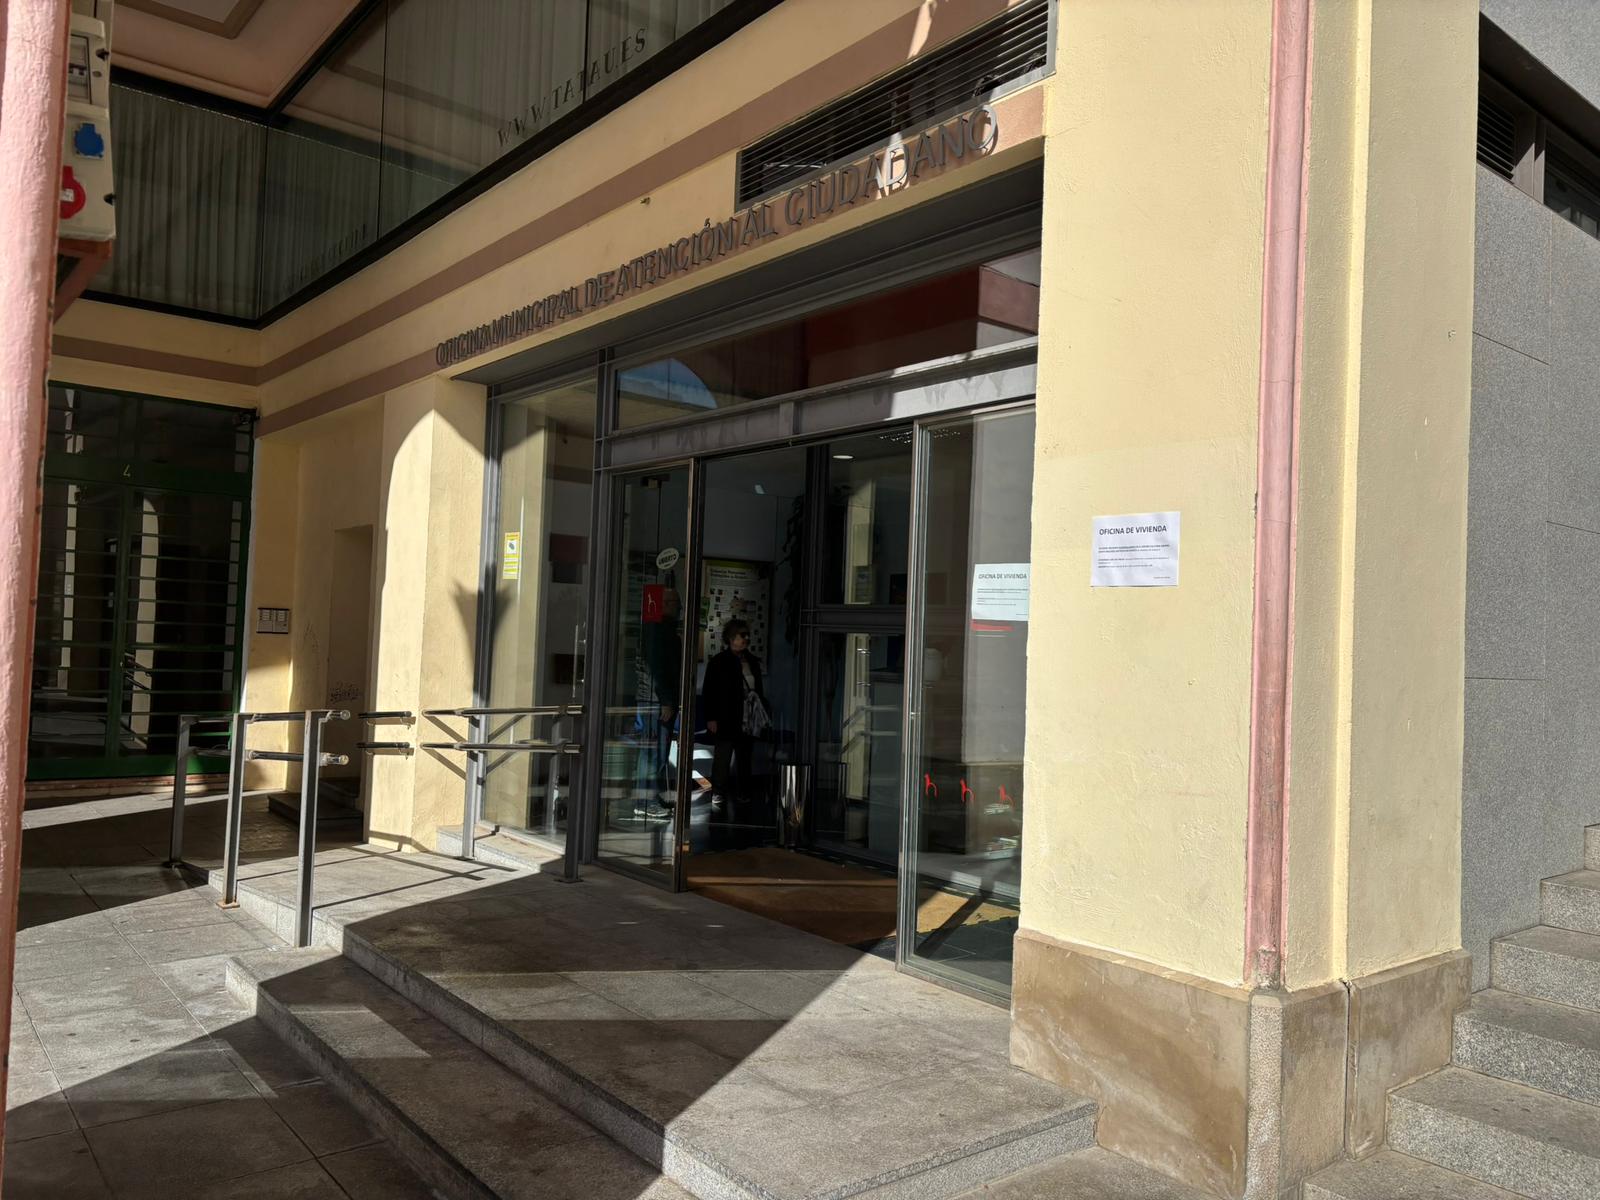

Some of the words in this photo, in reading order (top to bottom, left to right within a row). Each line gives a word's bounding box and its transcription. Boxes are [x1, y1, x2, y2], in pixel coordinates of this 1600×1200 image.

[436, 324, 492, 366] OFICINA
[492, 286, 581, 344] MUNICIPAL
[585, 271, 615, 307] DE
[616, 217, 736, 296] ATENCIÓN
[742, 203, 777, 246] AL
[785, 105, 998, 225] CIUDADANO
[1099, 527, 1125, 536] OFICINA
[1126, 526, 1134, 534] DE
[1135, 525, 1167, 533] VIVIENDA
